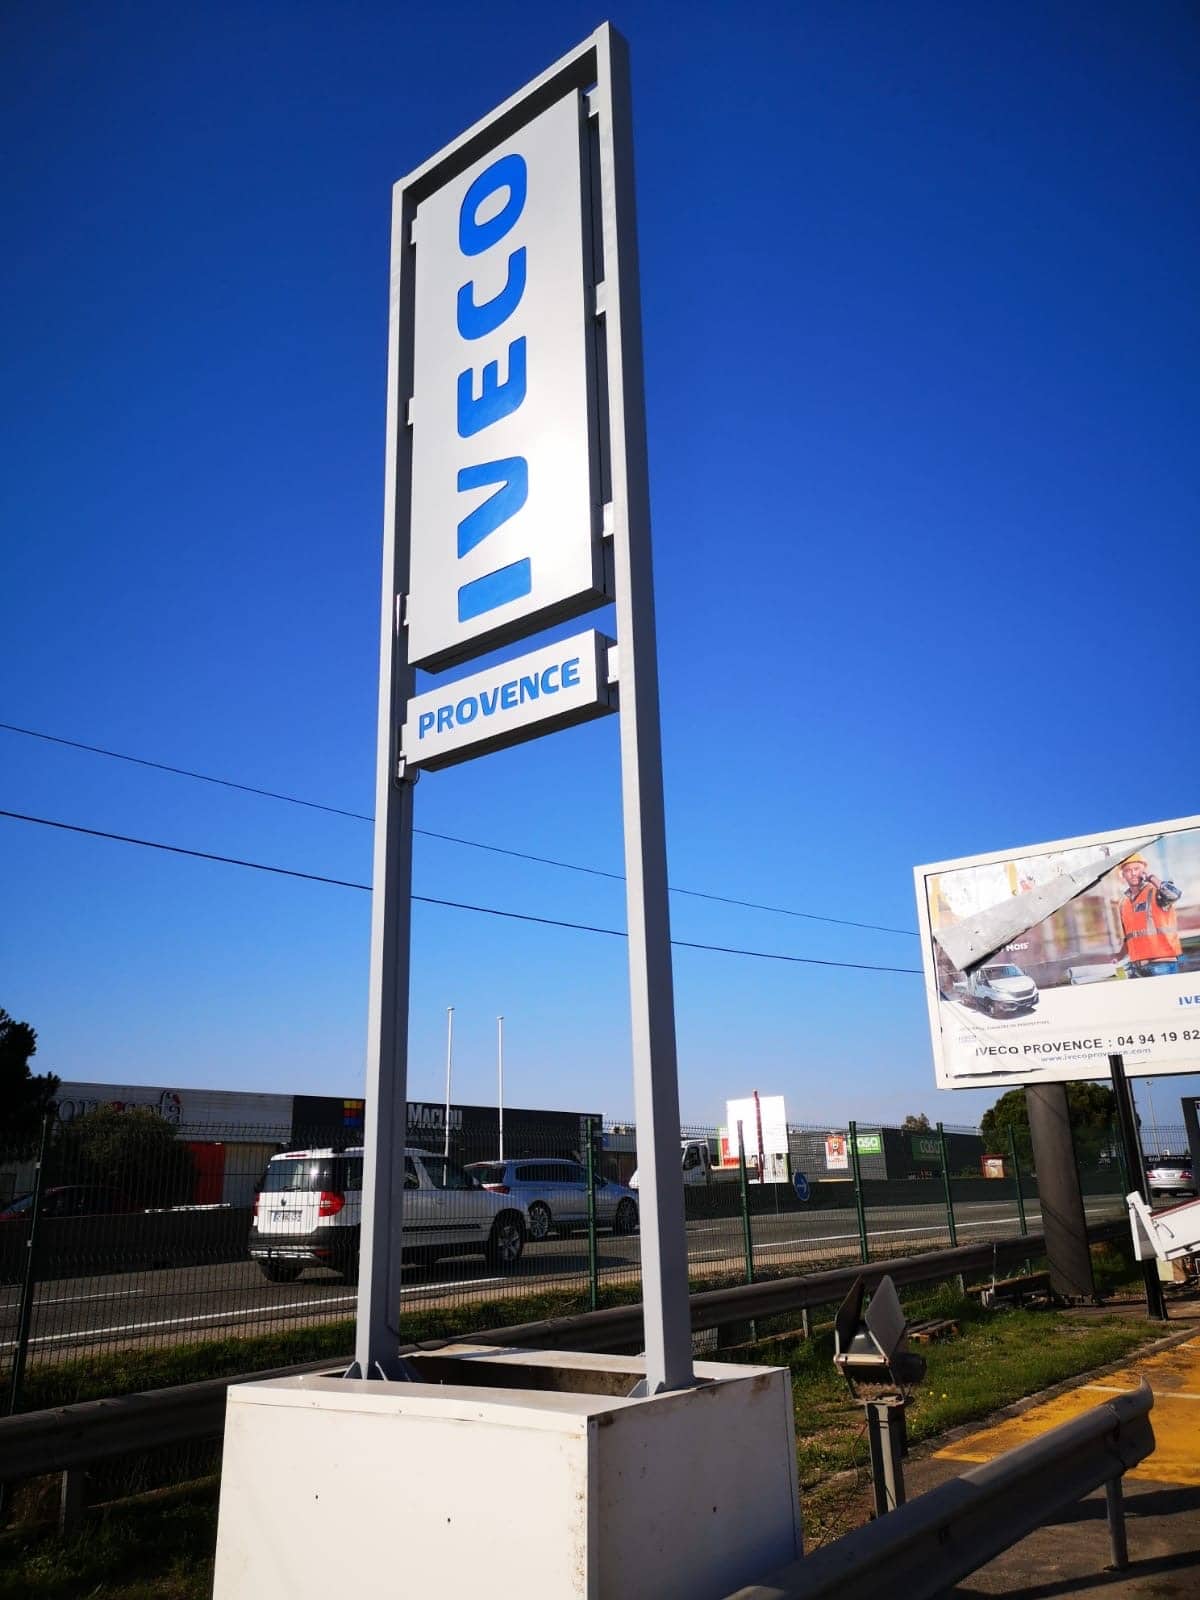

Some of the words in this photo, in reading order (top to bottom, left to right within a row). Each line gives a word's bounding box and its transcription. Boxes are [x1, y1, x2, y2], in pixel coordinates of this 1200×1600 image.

[458, 153, 531, 623] IVECO
[419, 657, 581, 740] PROVENCE
[976, 1046, 1019, 1057] IVECO
[1023, 1038, 1103, 1055] PROVENCE
[1117, 1035, 1134, 1046] 04
[1138, 1034, 1155, 1045] 94
[1161, 1032, 1177, 1043] 19
[1183, 1029, 1200, 1041] 82
